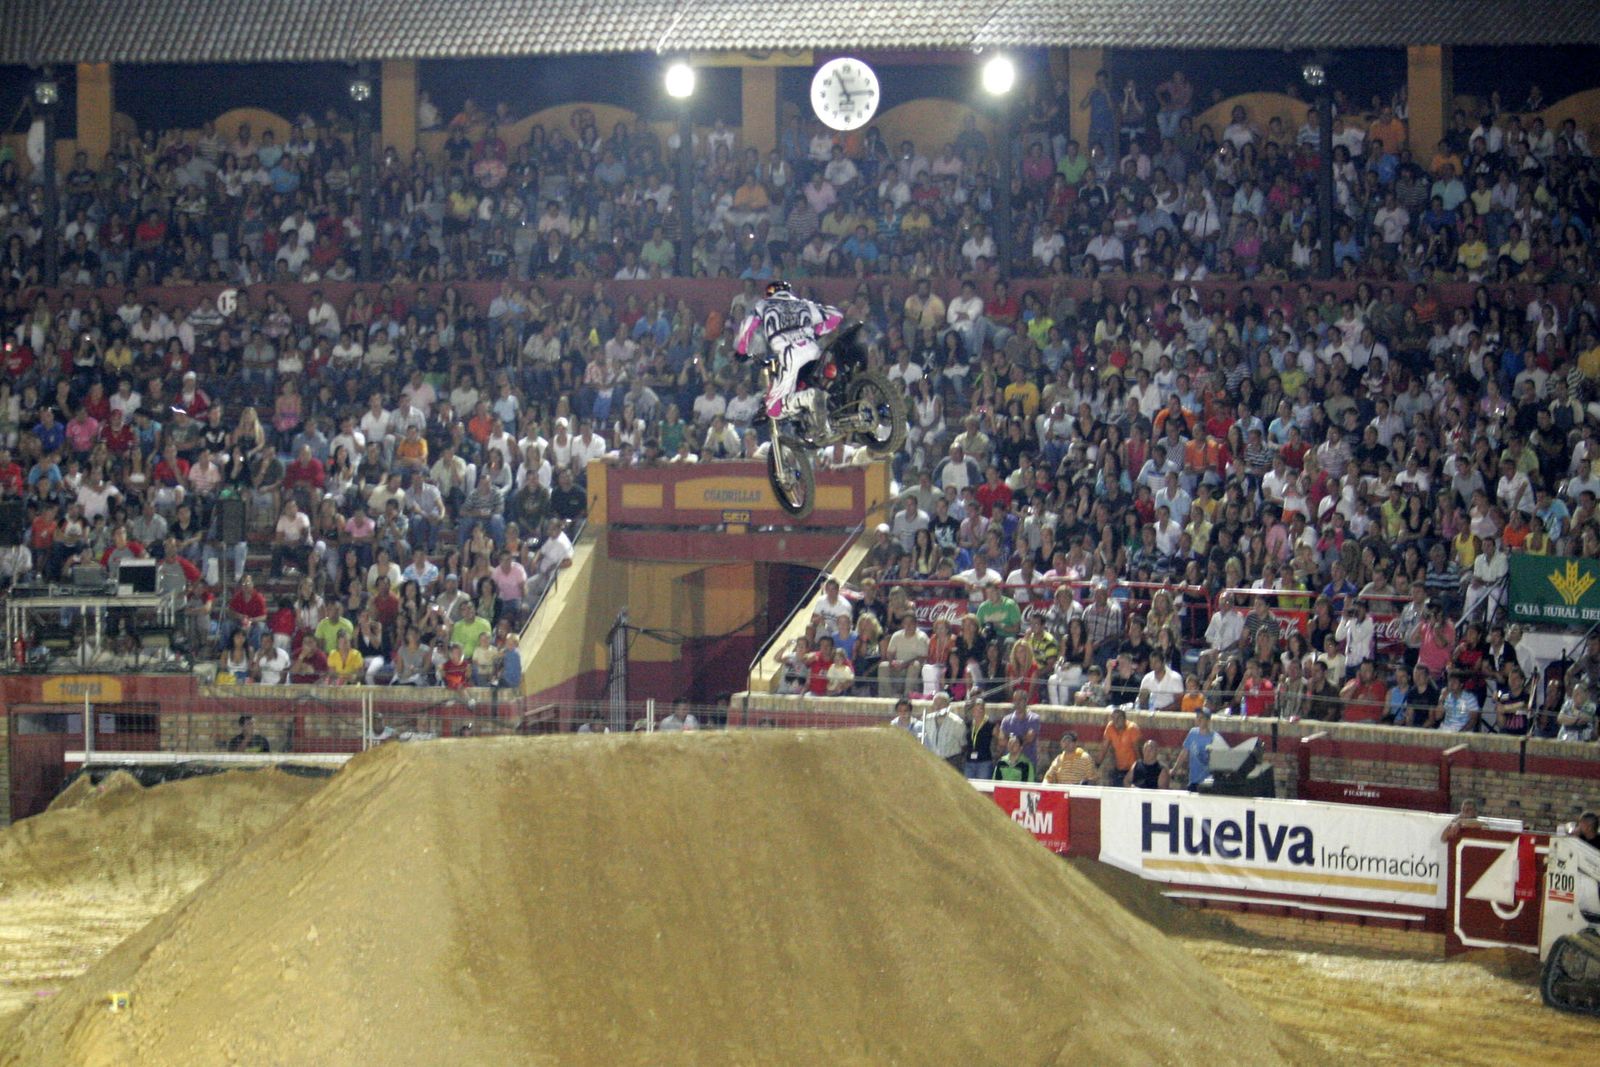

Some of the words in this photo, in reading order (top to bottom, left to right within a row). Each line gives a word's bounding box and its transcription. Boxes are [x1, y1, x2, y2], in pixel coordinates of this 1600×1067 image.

[703, 488, 763, 503] CUADRILLAS
[1543, 605, 1580, 619] RURAL
[1141, 801, 1315, 867] Huelva
[1320, 845, 1440, 880] Información
[1549, 872, 1575, 893] T200
